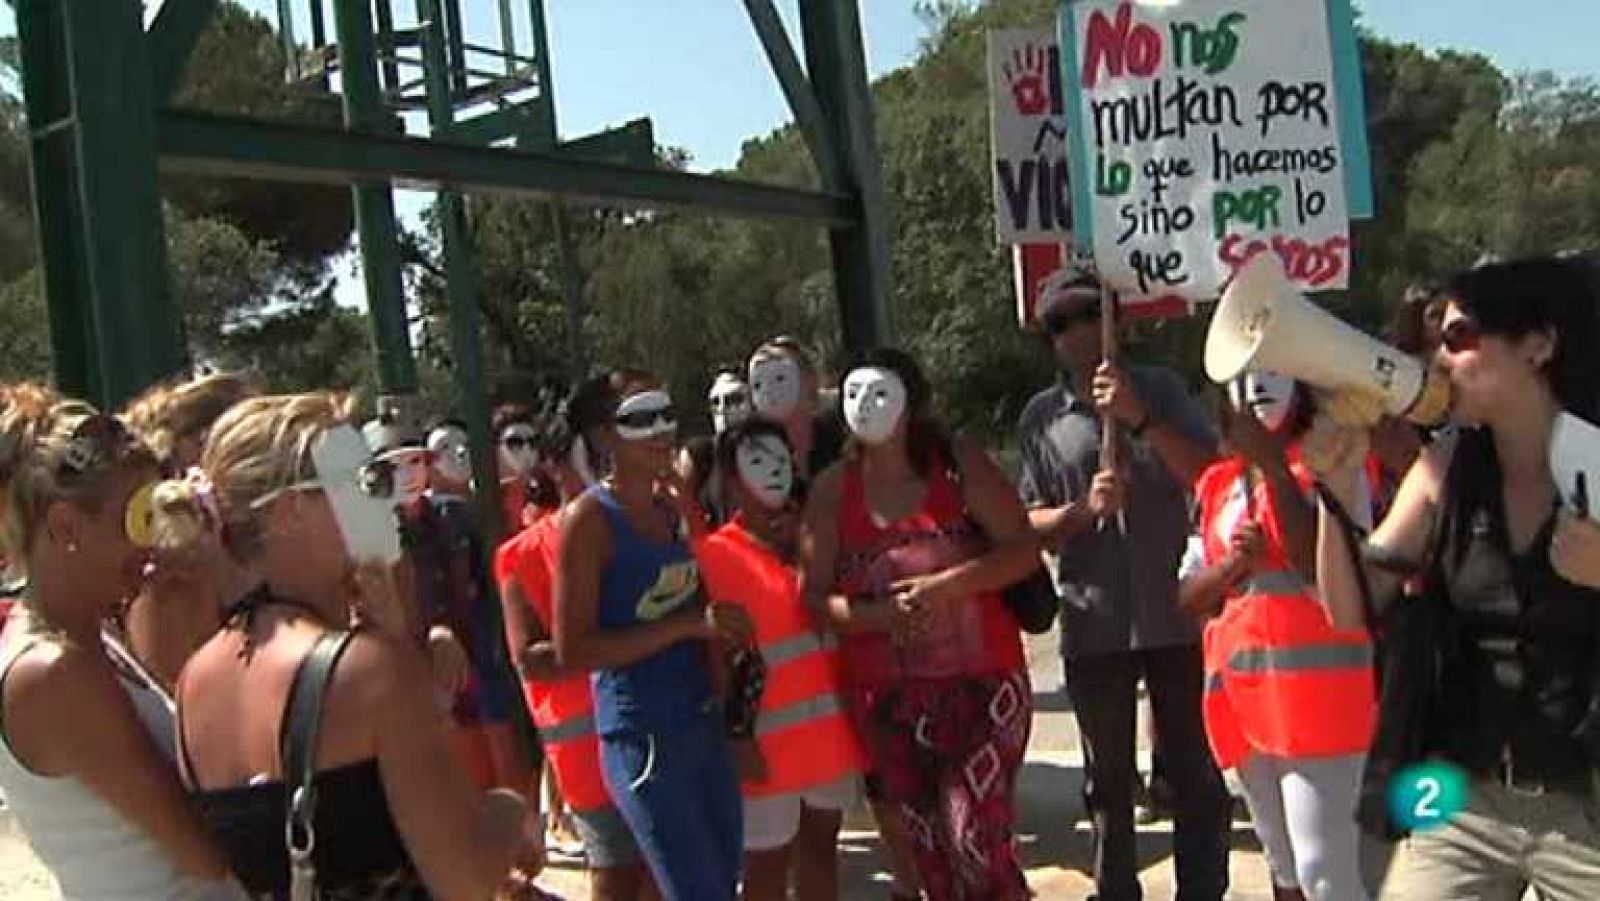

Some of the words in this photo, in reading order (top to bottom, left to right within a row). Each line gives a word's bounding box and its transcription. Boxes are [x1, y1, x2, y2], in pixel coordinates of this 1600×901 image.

[1082, 2, 1161, 89] No
[1170, 12, 1246, 75] nos
[1143, 157, 1197, 202] que
[1212, 133, 1339, 183] hacemos
[1117, 202, 1195, 246] sino
[1295, 177, 1326, 225] lo
[1129, 249, 1189, 294] que
